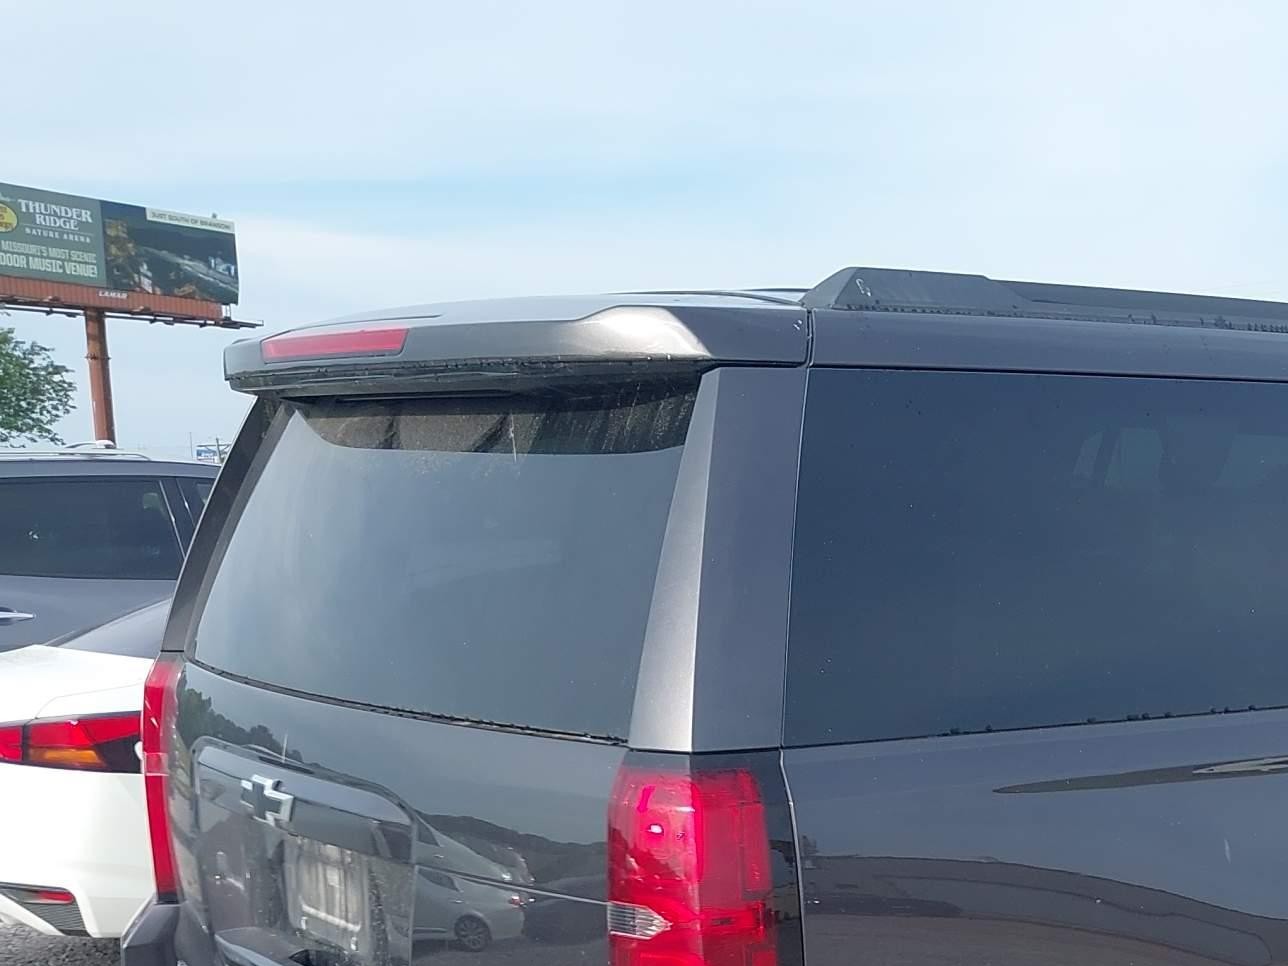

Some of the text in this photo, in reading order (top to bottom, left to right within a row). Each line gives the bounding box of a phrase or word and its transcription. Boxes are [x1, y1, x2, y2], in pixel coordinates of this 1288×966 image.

[18, 199, 93, 223] THUNDER
[35, 214, 79, 230] RIDGE
[25, 227, 91, 243] NATURE ARENA
[48, 247, 69, 260] MOST
[70, 250, 97, 264] SCENIC
[29, 256, 64, 273] MUSIC
[98, 290, 128, 300] LAMAR
